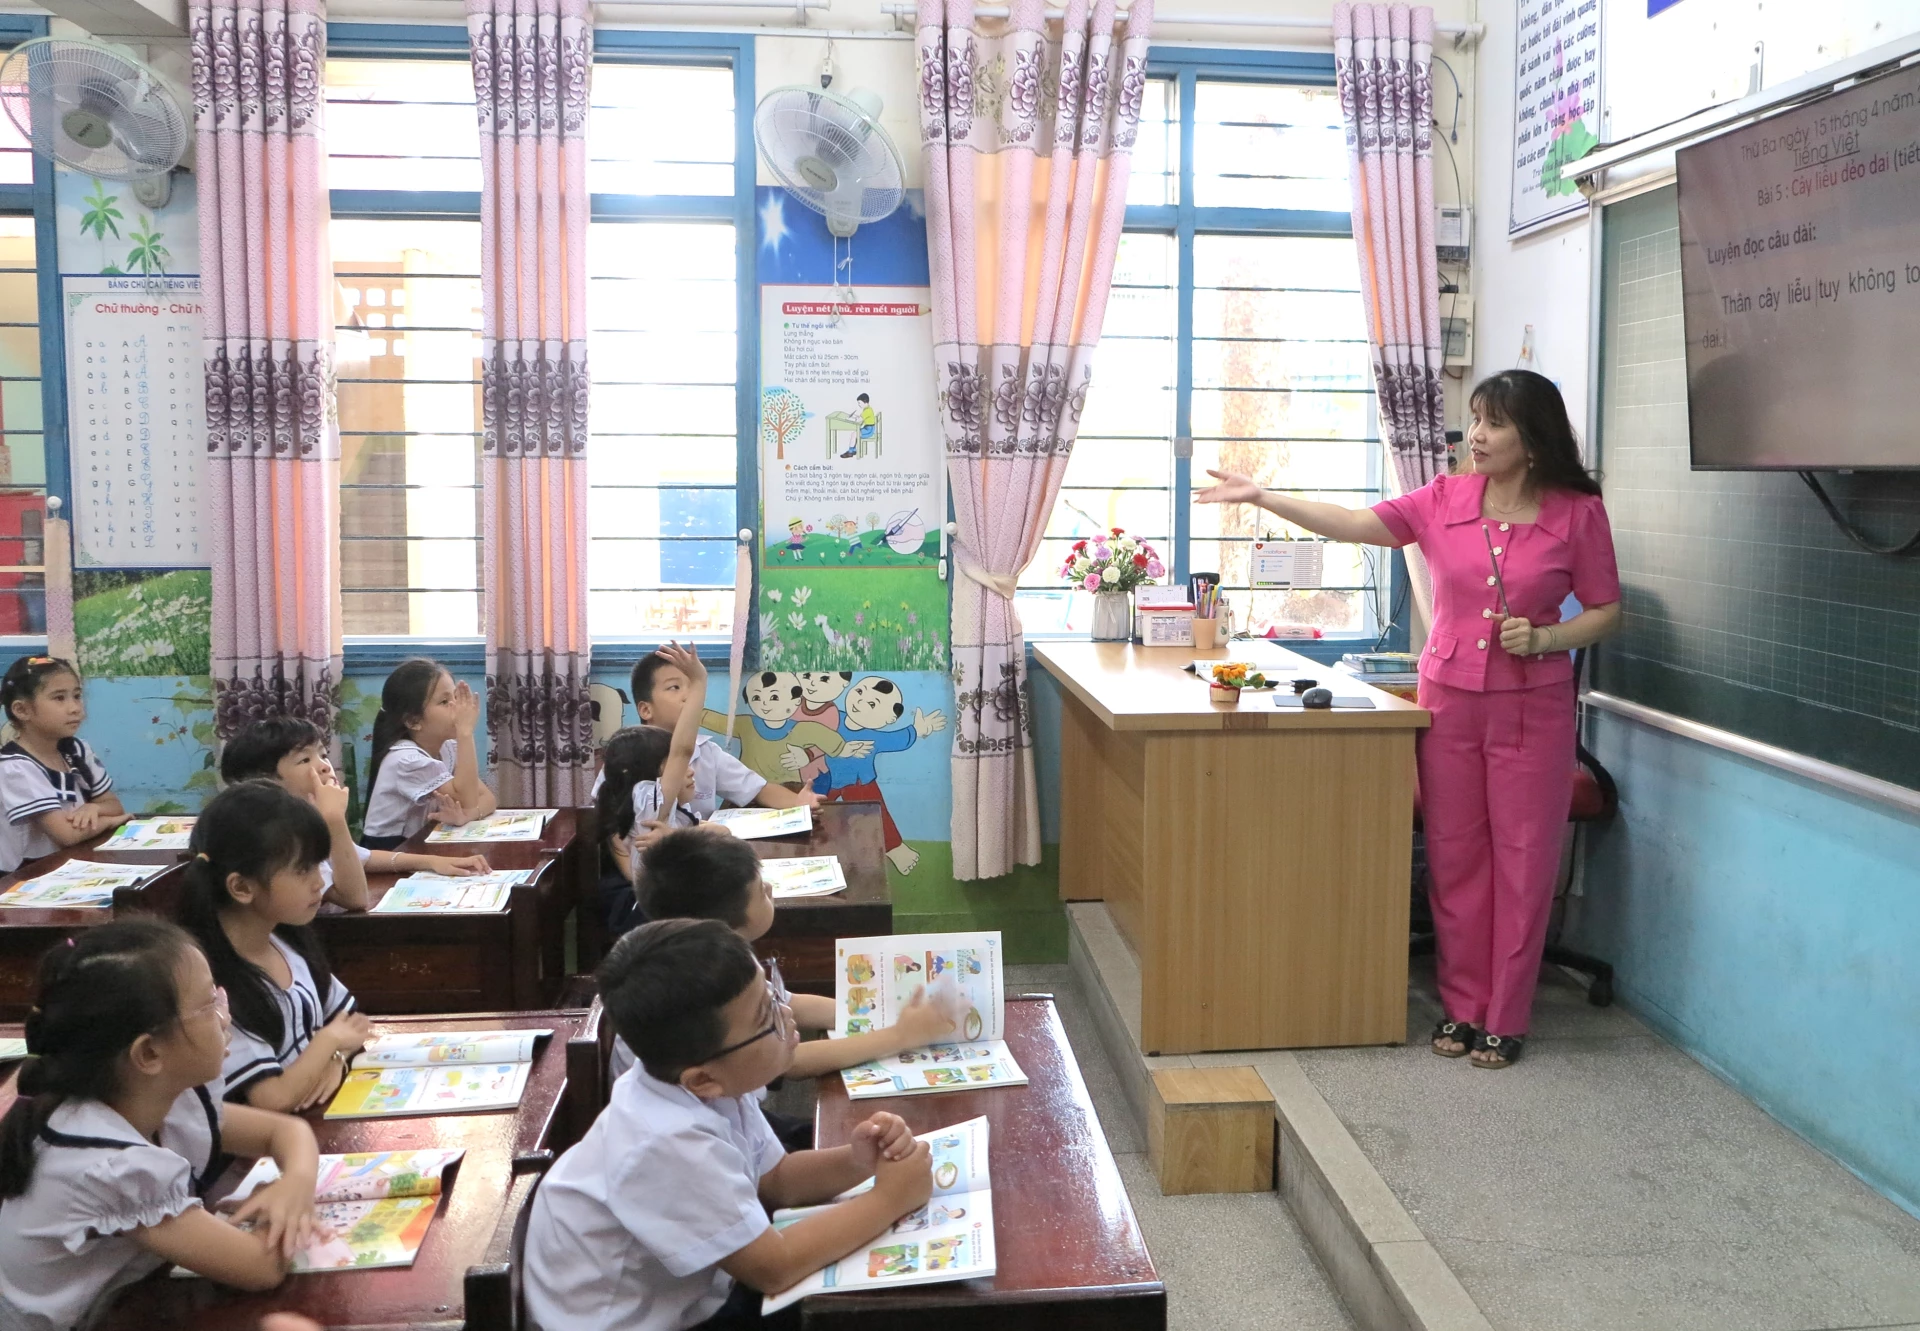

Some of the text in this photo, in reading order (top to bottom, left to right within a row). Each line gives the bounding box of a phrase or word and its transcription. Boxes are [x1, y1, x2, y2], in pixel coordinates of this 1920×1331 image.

[1741, 143, 1759, 161] Thứ
[1763, 138, 1776, 155] Ba
[1779, 126, 1810, 151] ngày
[1814, 118, 1827, 135] 15
[1829, 107, 1868, 132] tháng
[1870, 100, 1879, 118] 4
[1882, 92, 1914, 116] năm
[1793, 131, 1861, 167] Tiếng Việt
[1757, 185, 1774, 206] Bài
[1776, 184, 1783, 201] 5
[1785, 186, 1790, 199] :
[1791, 177, 1812, 198] Cây
[1815, 164, 1838, 191] liễu
[1841, 158, 1866, 184] dẻo
[1869, 152, 1889, 175] dai
[1707, 222, 1817, 266] Luyện đọc câu dài:
[95, 302, 118, 314] Chữ
[120, 303, 159, 316] thường
[169, 302, 192, 314] Chữ
[786, 304, 814, 315] Luyện
[816, 304, 831, 313] nét
[855, 304, 871, 313] rèn
[873, 304, 888, 314] nết
[890, 305, 916, 316] người
[1721, 293, 1752, 315] Thân
[1758, 287, 1781, 312] cây
[1787, 277, 1811, 304] liễu
[1848, 267, 1896, 293] không
